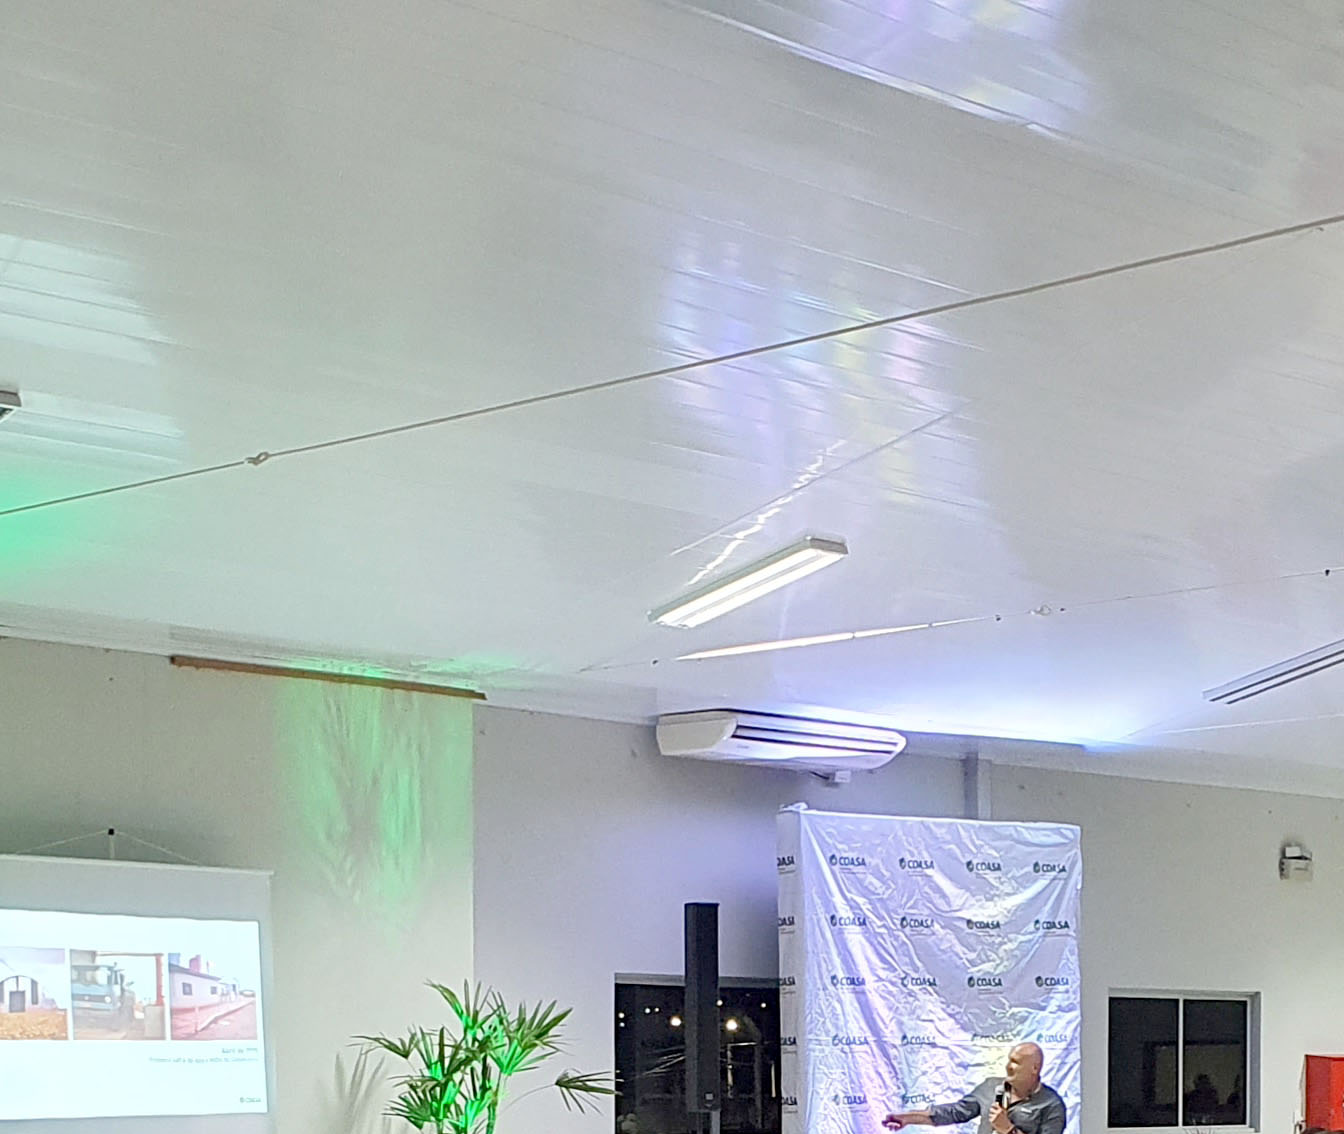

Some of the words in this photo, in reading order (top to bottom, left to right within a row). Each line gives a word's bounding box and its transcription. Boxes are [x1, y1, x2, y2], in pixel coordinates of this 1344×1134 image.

[838, 856, 866, 866] COASA
[907, 859, 935, 870] COASA
[975, 862, 1002, 872] COASA
[1041, 863, 1067, 873] COASA
[838, 916, 867, 926] COASA
[974, 919, 1001, 929] COASA
[1042, 920, 1070, 930] COASA
[840, 977, 866, 986] COASA
[910, 977, 938, 987] COASA
[976, 977, 1003, 987] COASA
[1043, 977, 1069, 986] COASA
[840, 1036, 869, 1046] COASA
[842, 1095, 868, 1105] COASA
